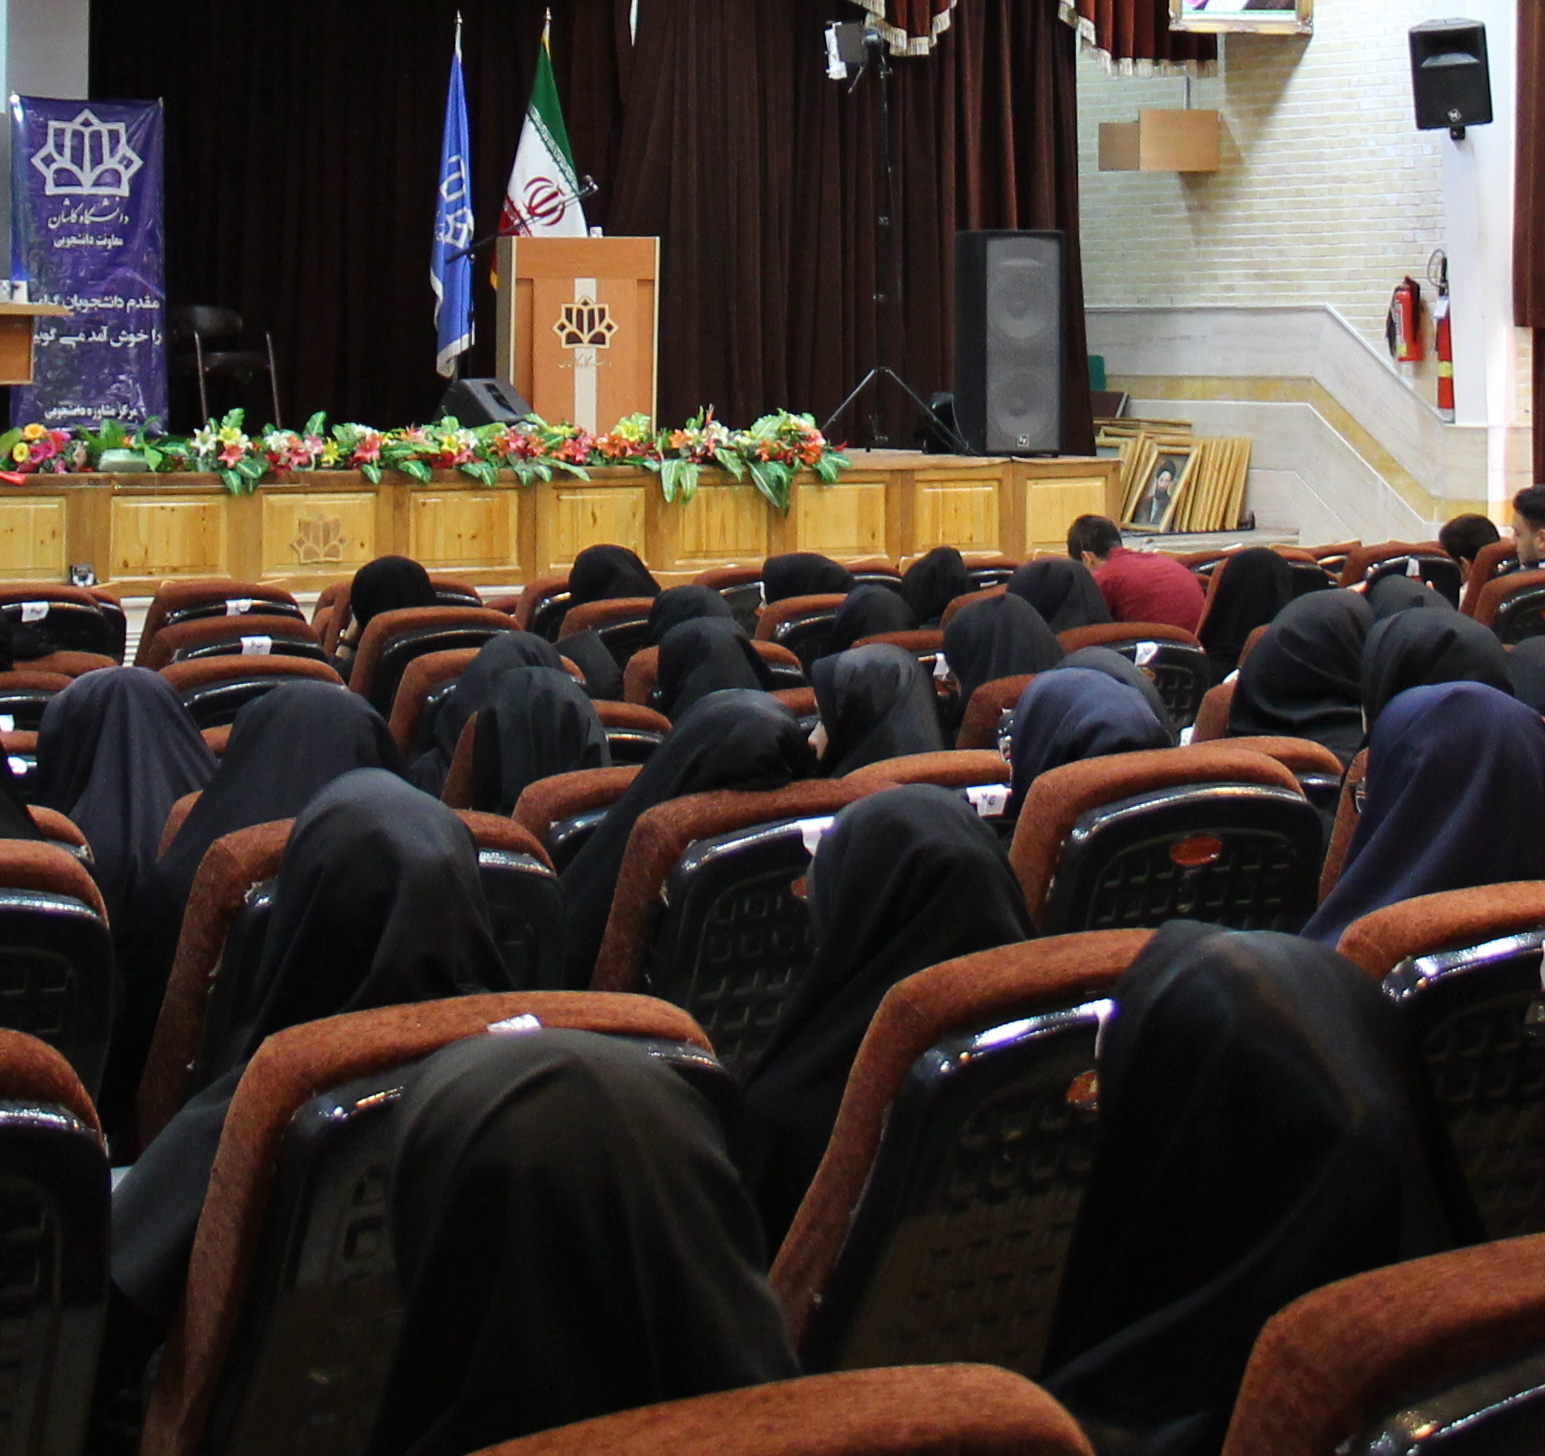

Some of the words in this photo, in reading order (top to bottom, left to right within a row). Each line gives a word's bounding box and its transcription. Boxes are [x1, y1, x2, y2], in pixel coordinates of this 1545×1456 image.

[47, 197, 84, 229] کاشان
[78, 197, 130, 225] دانشگاه
[95, 233, 124, 250] معاونت
[62, 294, 125, 315] دانشجویان
[126, 294, 161, 314] مقدم
[59, 333, 87, 349] می
[87, 326, 110, 343] آمد
[109, 328, 150, 348] خوش
[151, 328, 162, 345] را
[86, 404, 117, 420] مشاوره
[117, 404, 138, 420] مرکز
